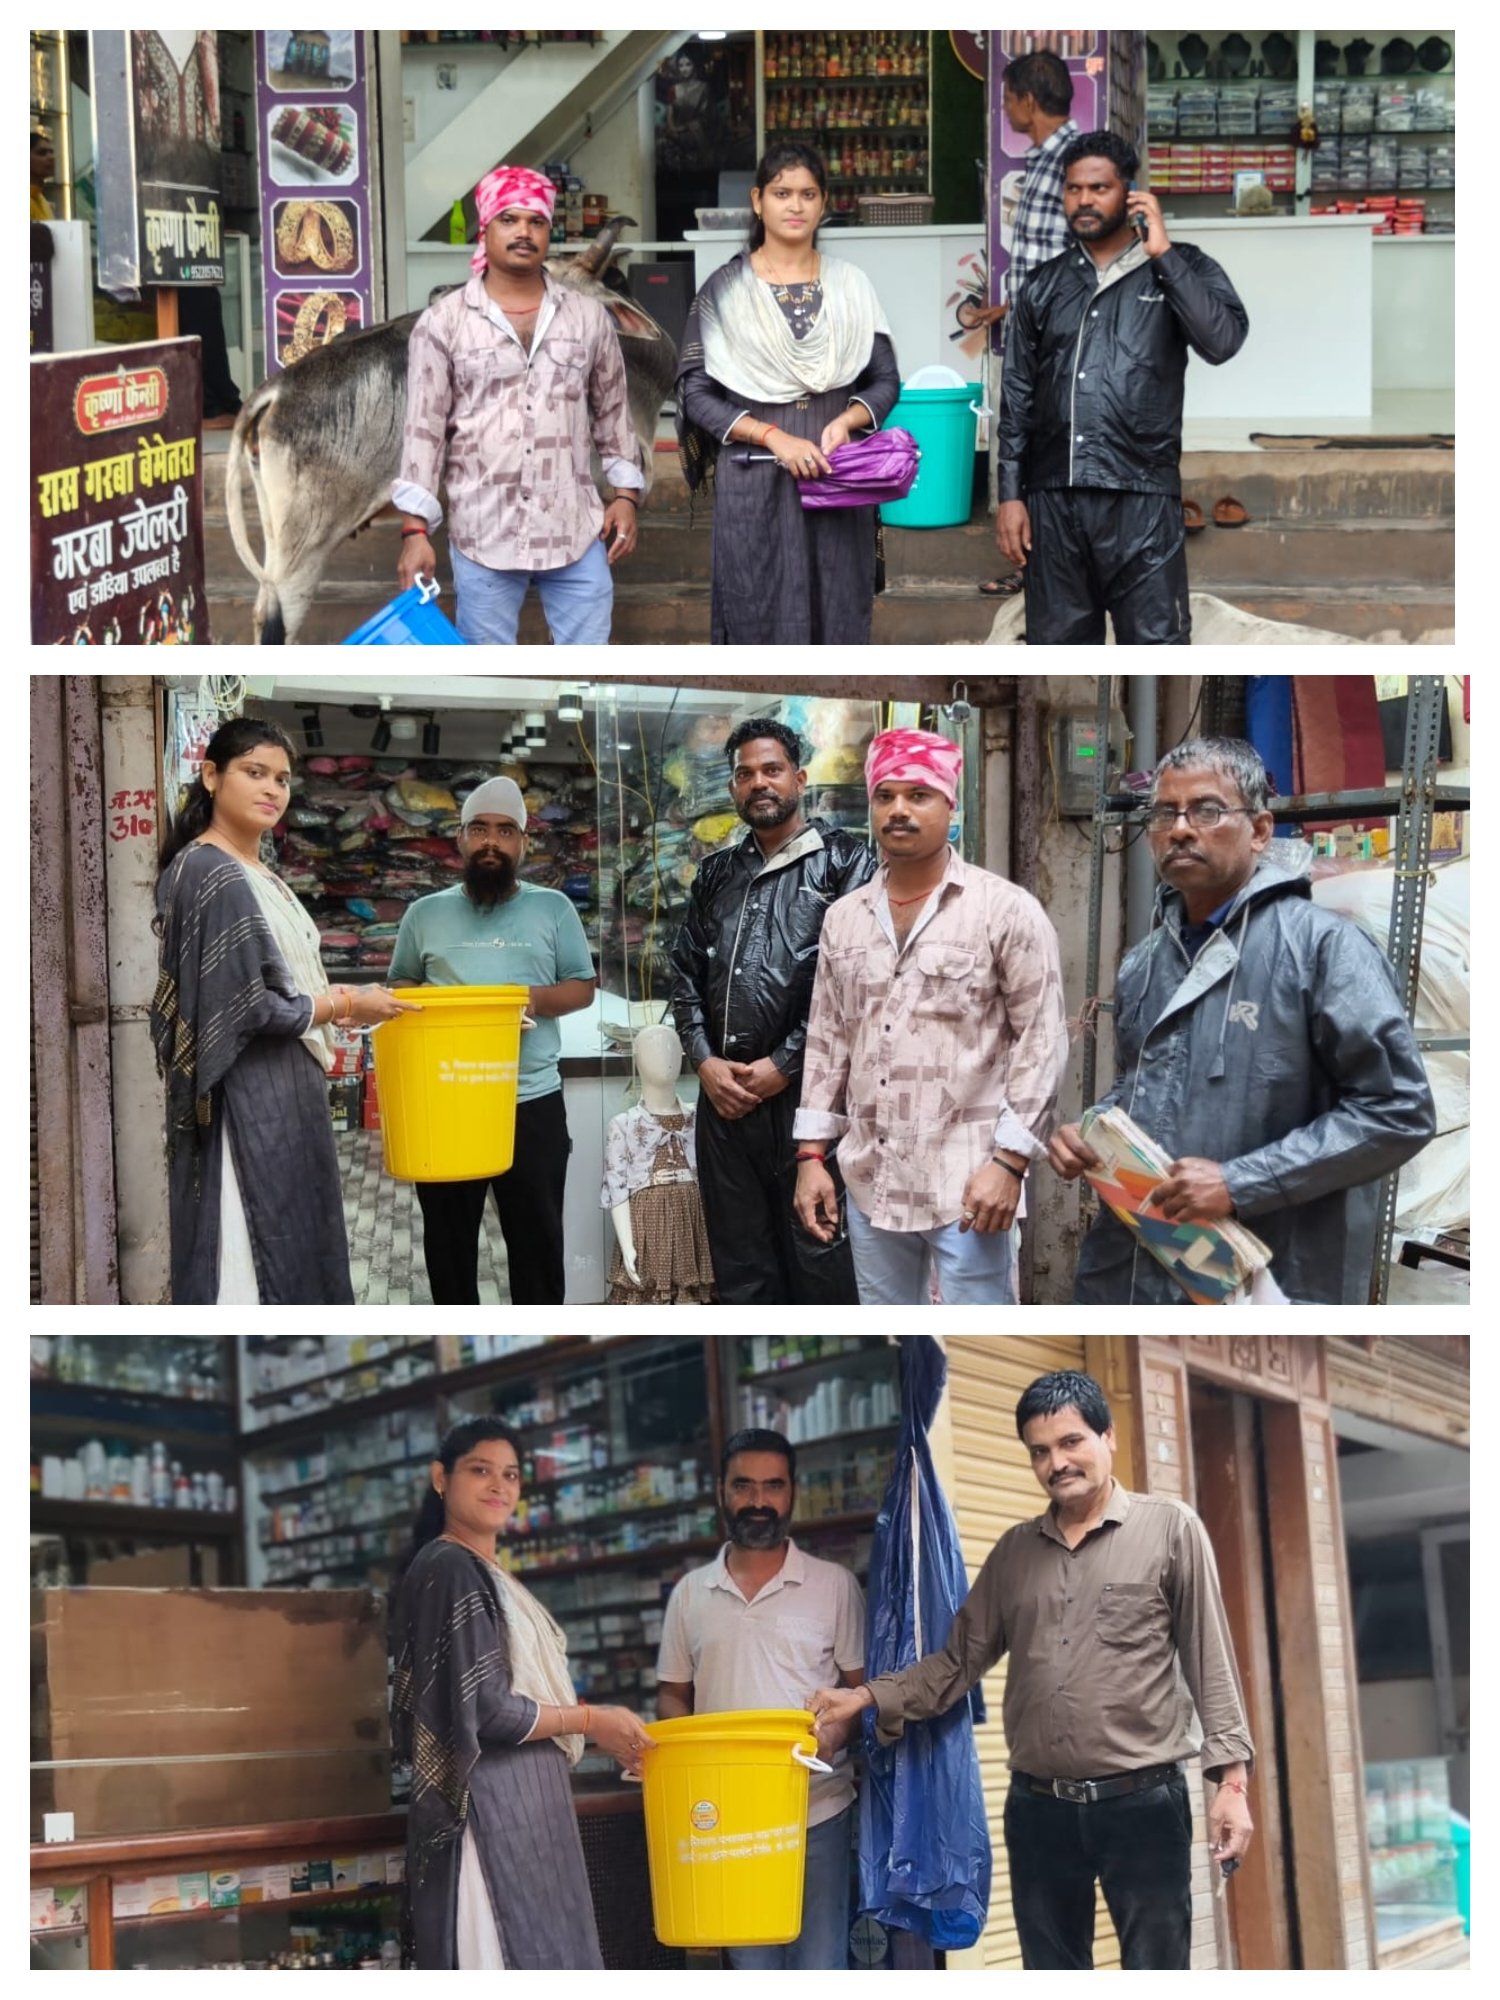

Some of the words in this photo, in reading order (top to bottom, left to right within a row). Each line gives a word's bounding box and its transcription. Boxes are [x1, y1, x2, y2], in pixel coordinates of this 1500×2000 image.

[144, 209, 184, 275] कृष्णा
[84, 387, 123, 428] कृष्णा
[38, 466, 80, 518] रास
[84, 453, 135, 502] गरबा
[138, 433, 196, 487] बेमेतरा
[52, 520, 113, 580] गरबा
[118, 485, 188, 559] ज्वेलरी
[68, 581, 88, 614] एवं
[130, 556, 170, 589] उपलब्ध
